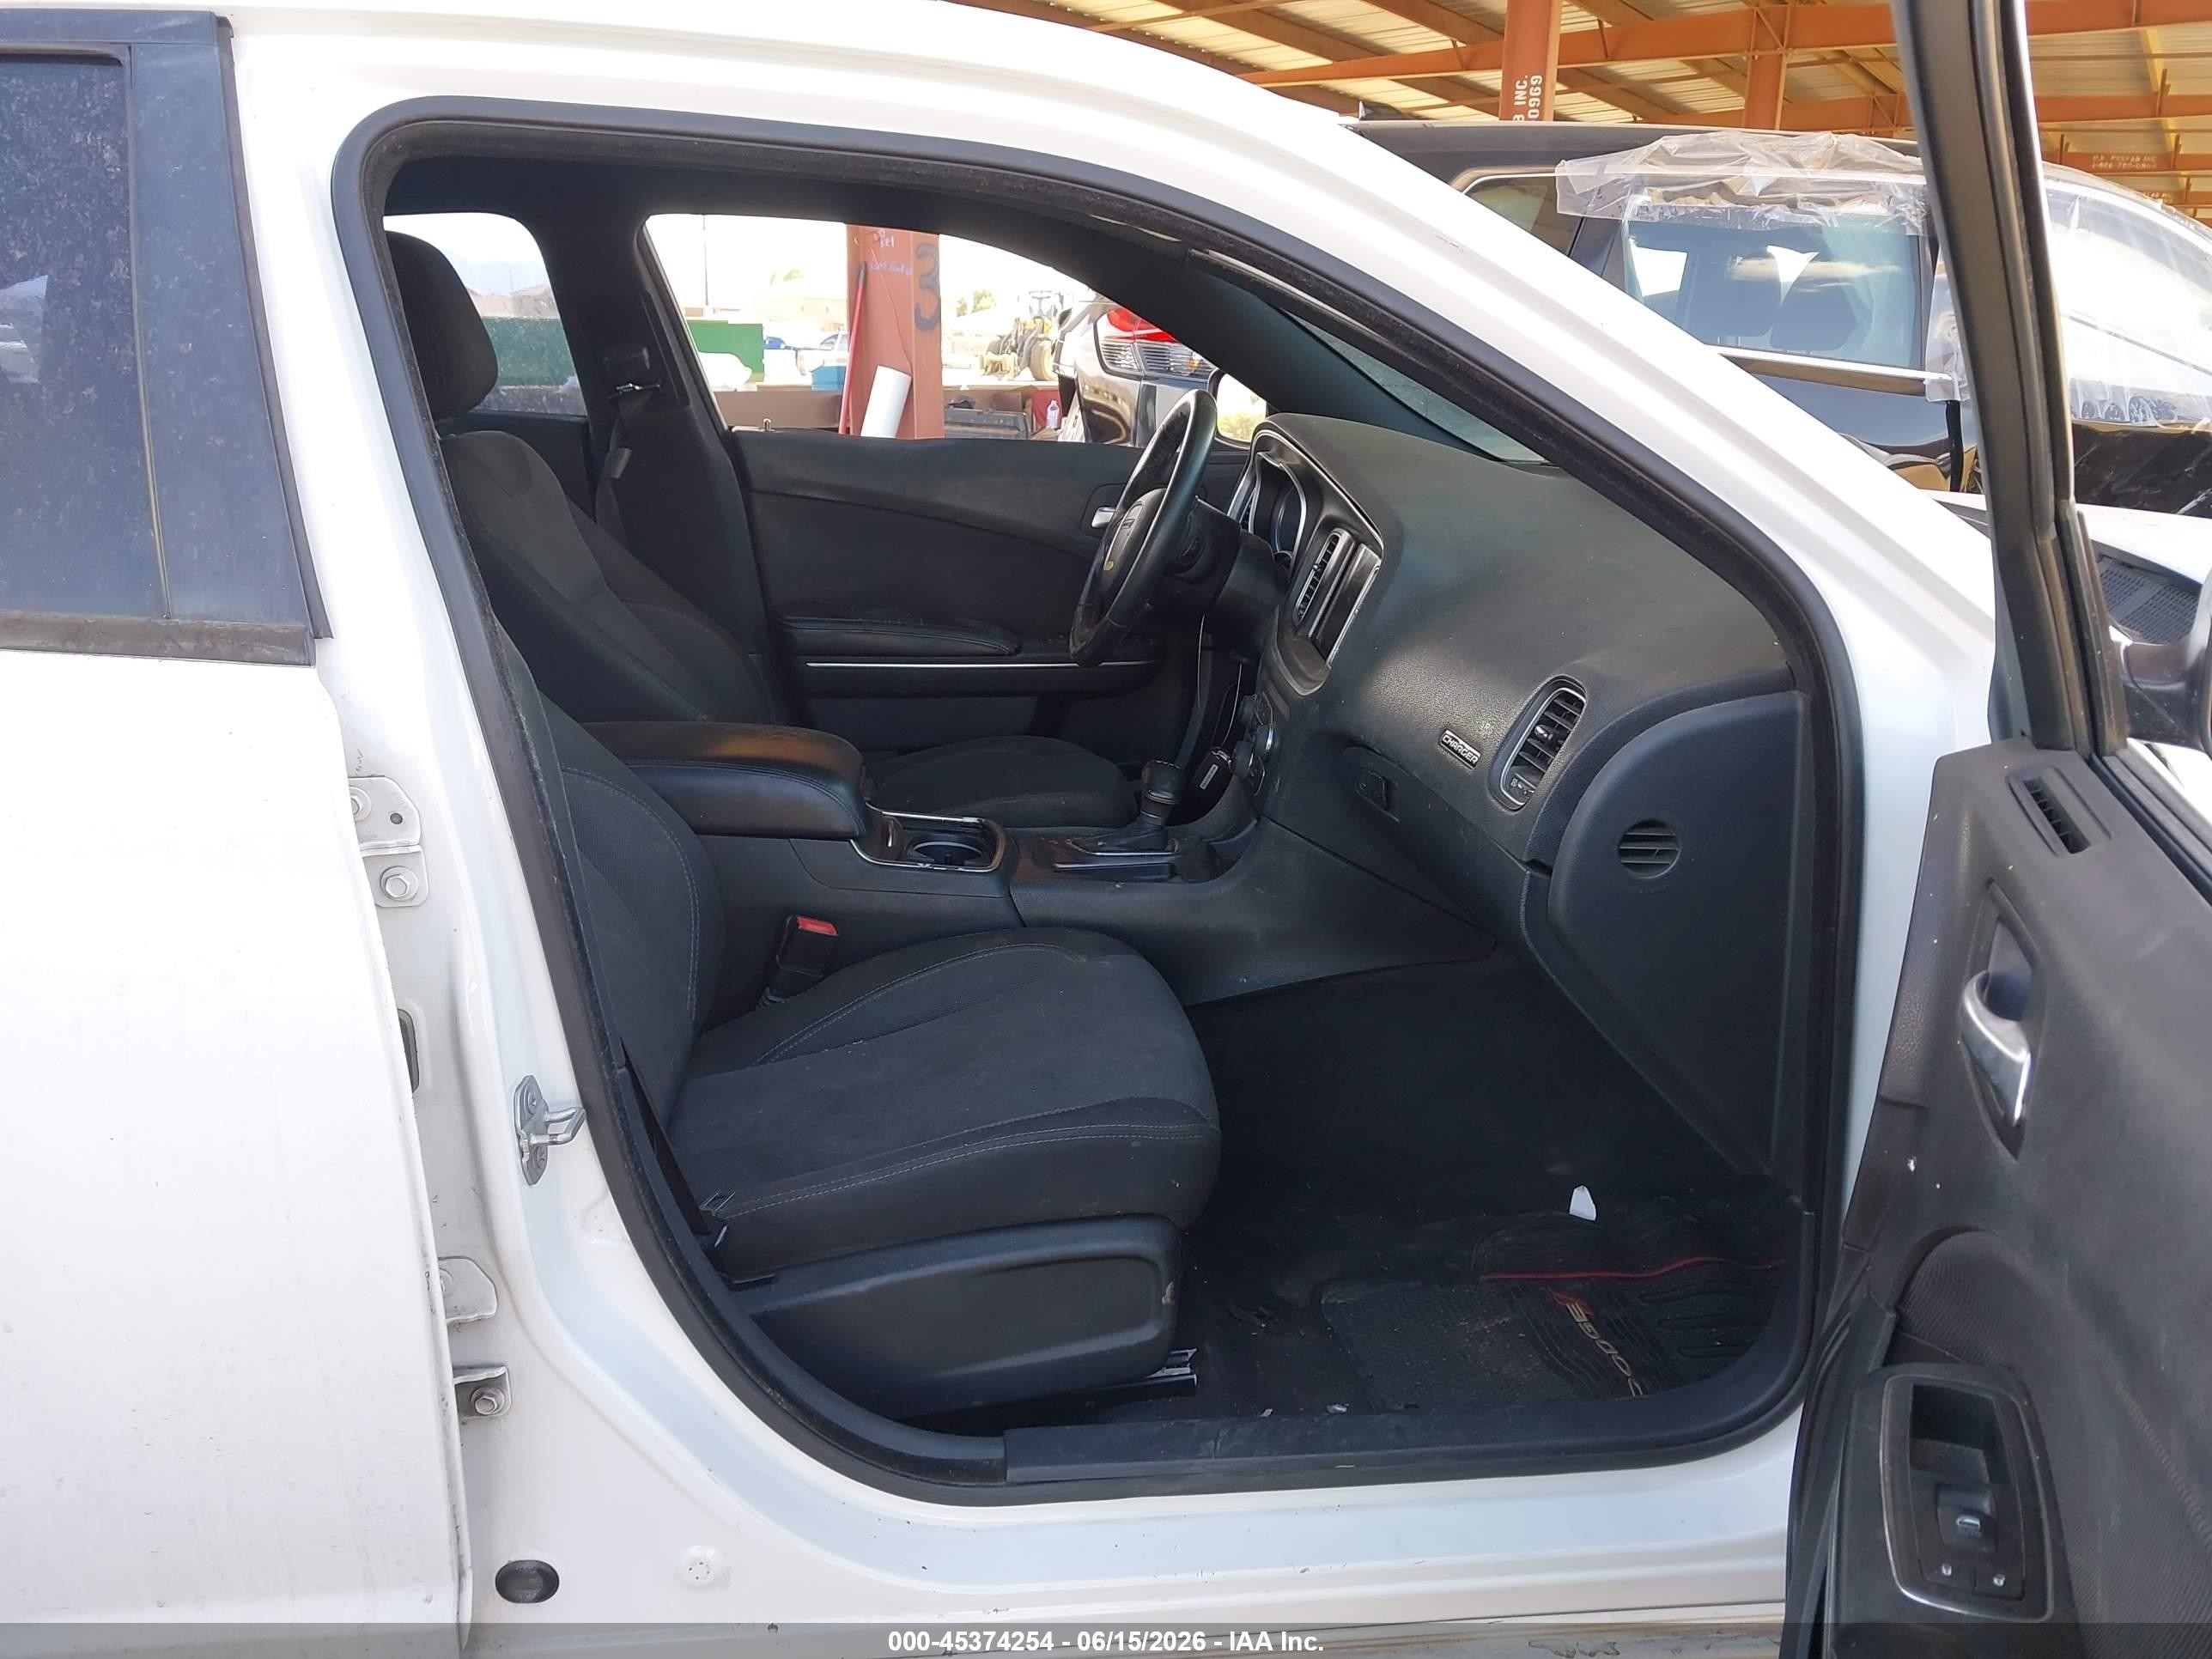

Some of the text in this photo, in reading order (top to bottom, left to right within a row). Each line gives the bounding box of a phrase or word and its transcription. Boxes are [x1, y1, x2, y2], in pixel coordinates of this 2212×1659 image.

[1514, 75, 1528, 106] INC.
[1528, 75, 1543, 118] 0969
[914, 242, 940, 331] 3
[1443, 734, 1479, 764] CHARGER
